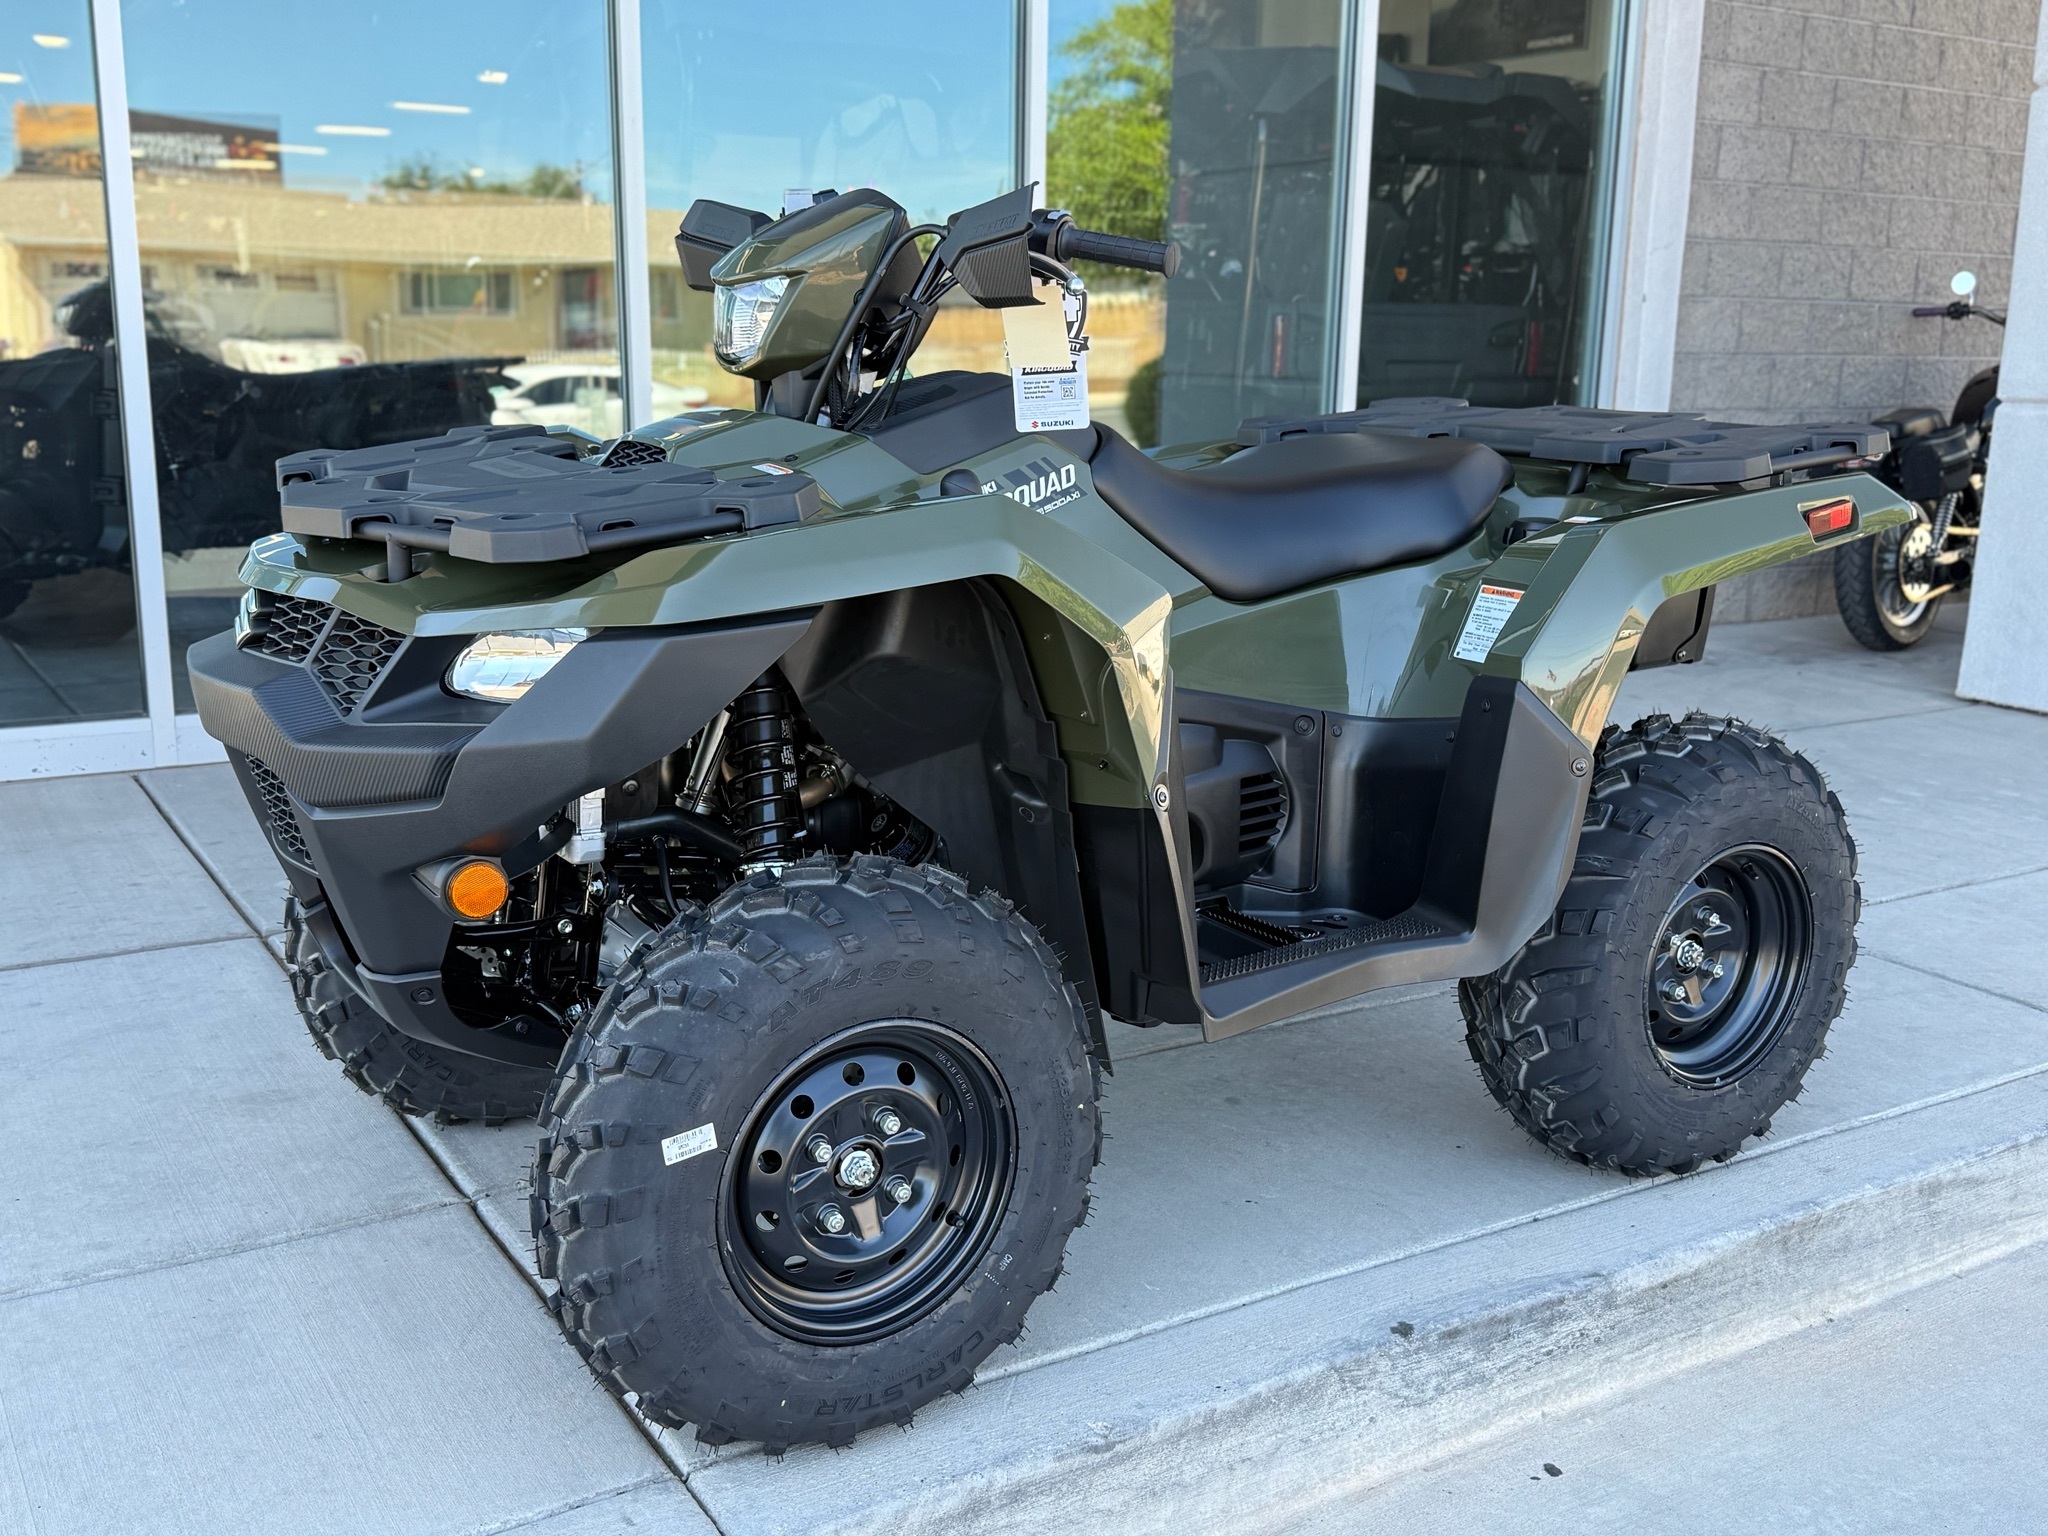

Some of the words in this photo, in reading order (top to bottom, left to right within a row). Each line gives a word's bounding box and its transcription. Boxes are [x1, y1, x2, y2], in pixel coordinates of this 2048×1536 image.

[1004, 463, 1076, 507] QUAD
[768, 958, 936, 1037] AT489
[813, 1329, 986, 1418] CARLSTAR
